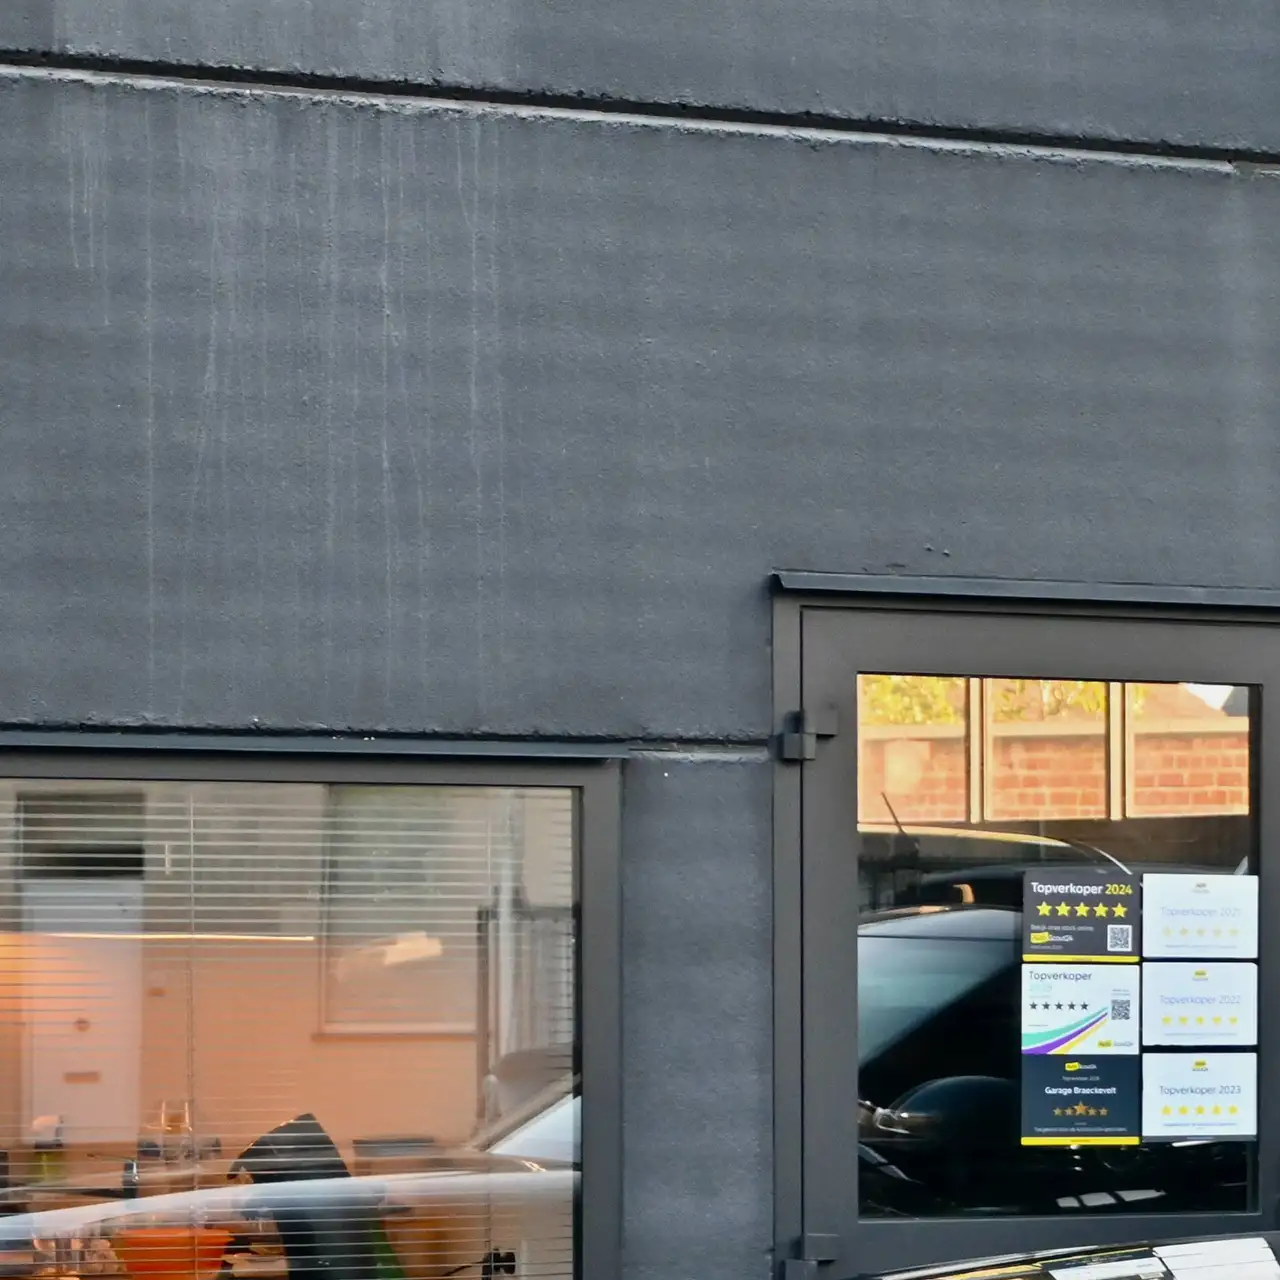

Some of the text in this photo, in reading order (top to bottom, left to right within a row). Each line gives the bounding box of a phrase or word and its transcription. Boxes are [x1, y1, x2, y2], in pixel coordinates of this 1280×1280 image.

[1030, 882, 1133, 896] Topverkoper 2024
[1160, 907, 1218, 919] Topverkoper
[1029, 970, 1093, 983] Topverkoper
[1160, 995, 1241, 1007] Topverkoper 2022
[1044, 1086, 1117, 1096] Garage Braeckevelt
[1160, 1086, 1241, 1097] Topverkoper 2023
